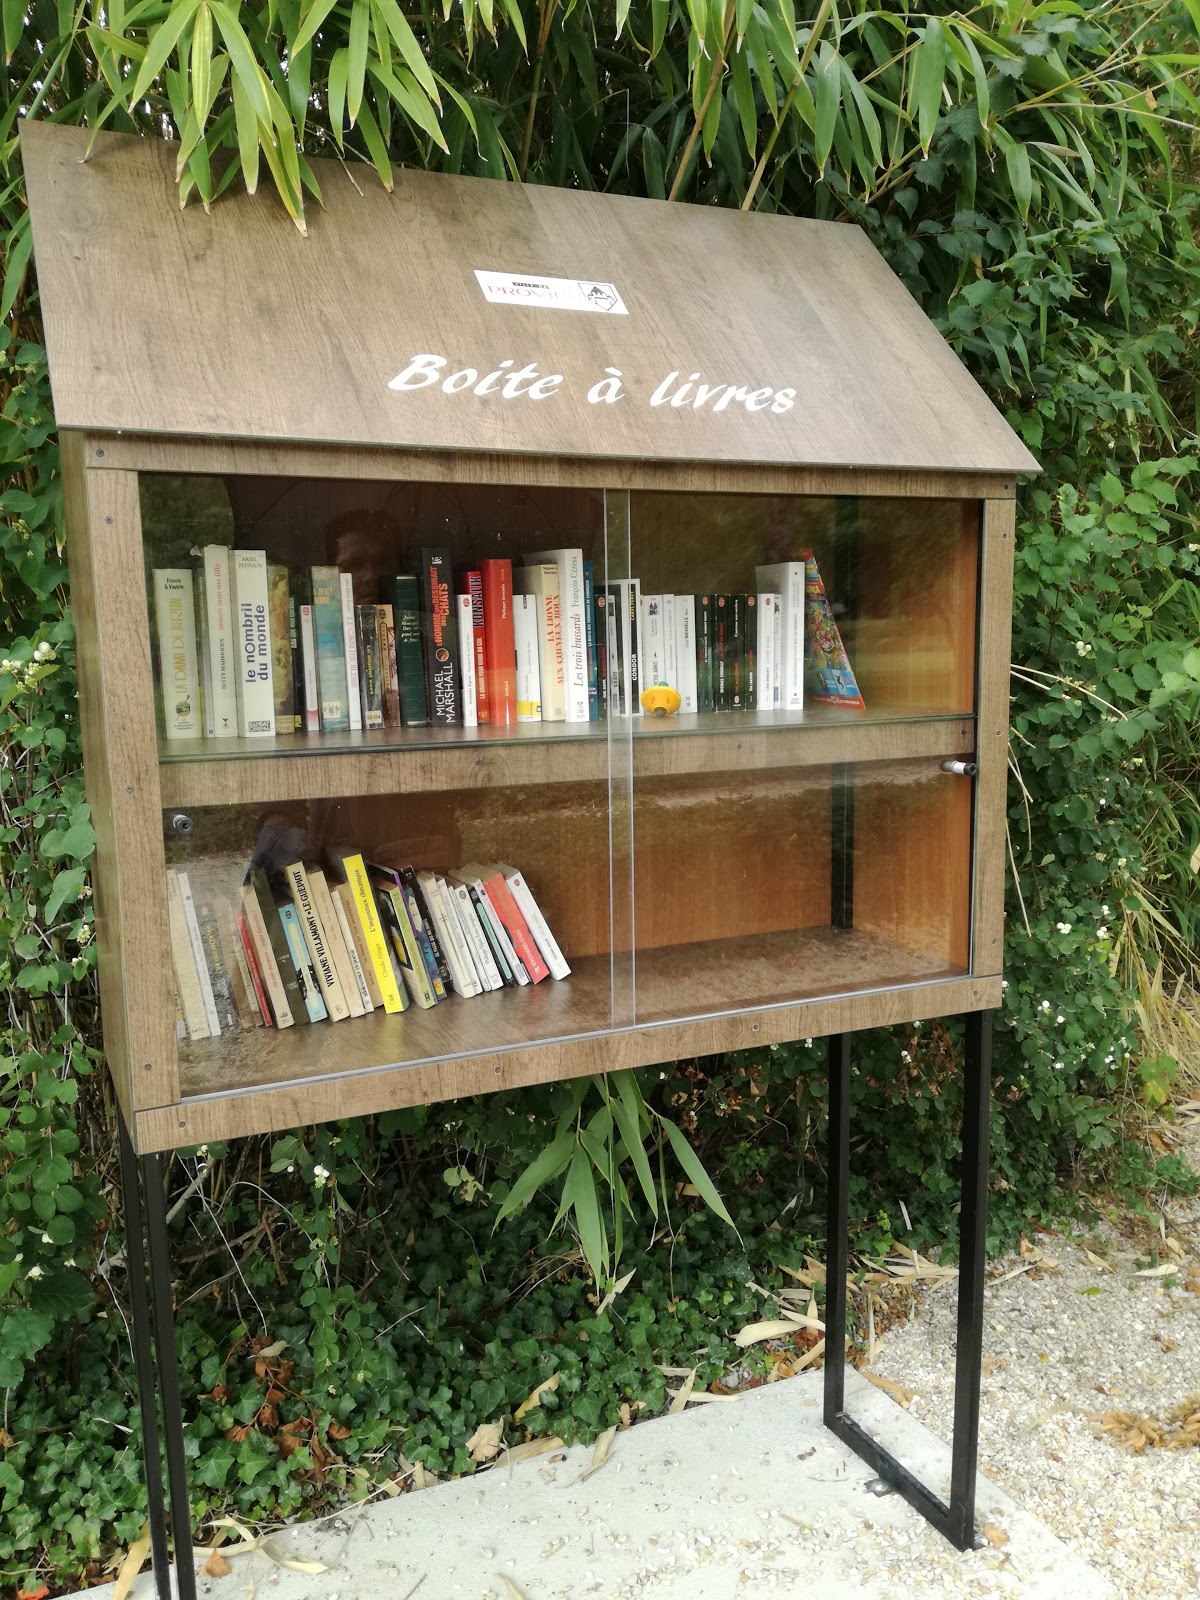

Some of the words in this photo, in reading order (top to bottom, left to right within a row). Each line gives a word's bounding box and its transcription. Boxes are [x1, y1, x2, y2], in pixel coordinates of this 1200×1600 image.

[387, 353, 564, 400] Boite
[587, 367, 626, 404] à
[650, 372, 797, 413] livres
[570, 556, 578, 578] Cérésa
[430, 566, 439, 604] DESSINAIT
[438, 583, 450, 616] CHATS
[572, 580, 580, 608] François
[168, 597, 182, 630] BERLIN
[216, 607, 224, 630] jamais
[546, 594, 554, 626] LIONNE
[172, 634, 184, 649] DE
[254, 604, 268, 656] monde
[547, 631, 555, 642] LA
[555, 623, 563, 664] CHEVEUX
[570, 613, 582, 649] hussards
[172, 651, 186, 681] DAME
[257, 663, 268, 680] du
[572, 651, 582, 670] trois
[246, 670, 256, 683] le
[573, 672, 584, 687] Les
[434, 670, 446, 716] MICHAEL
[442, 662, 456, 723] MARSHALL
[355, 869, 366, 898] climatique
[302, 900, 311, 912] LE
[363, 898, 376, 932] L'imposture
[308, 914, 325, 957] VILLAMONT
[515, 928, 525, 943] COLD
[522, 941, 538, 967] SHOULDER
[321, 956, 335, 987] VIVIANE
[379, 958, 388, 977] Claude
